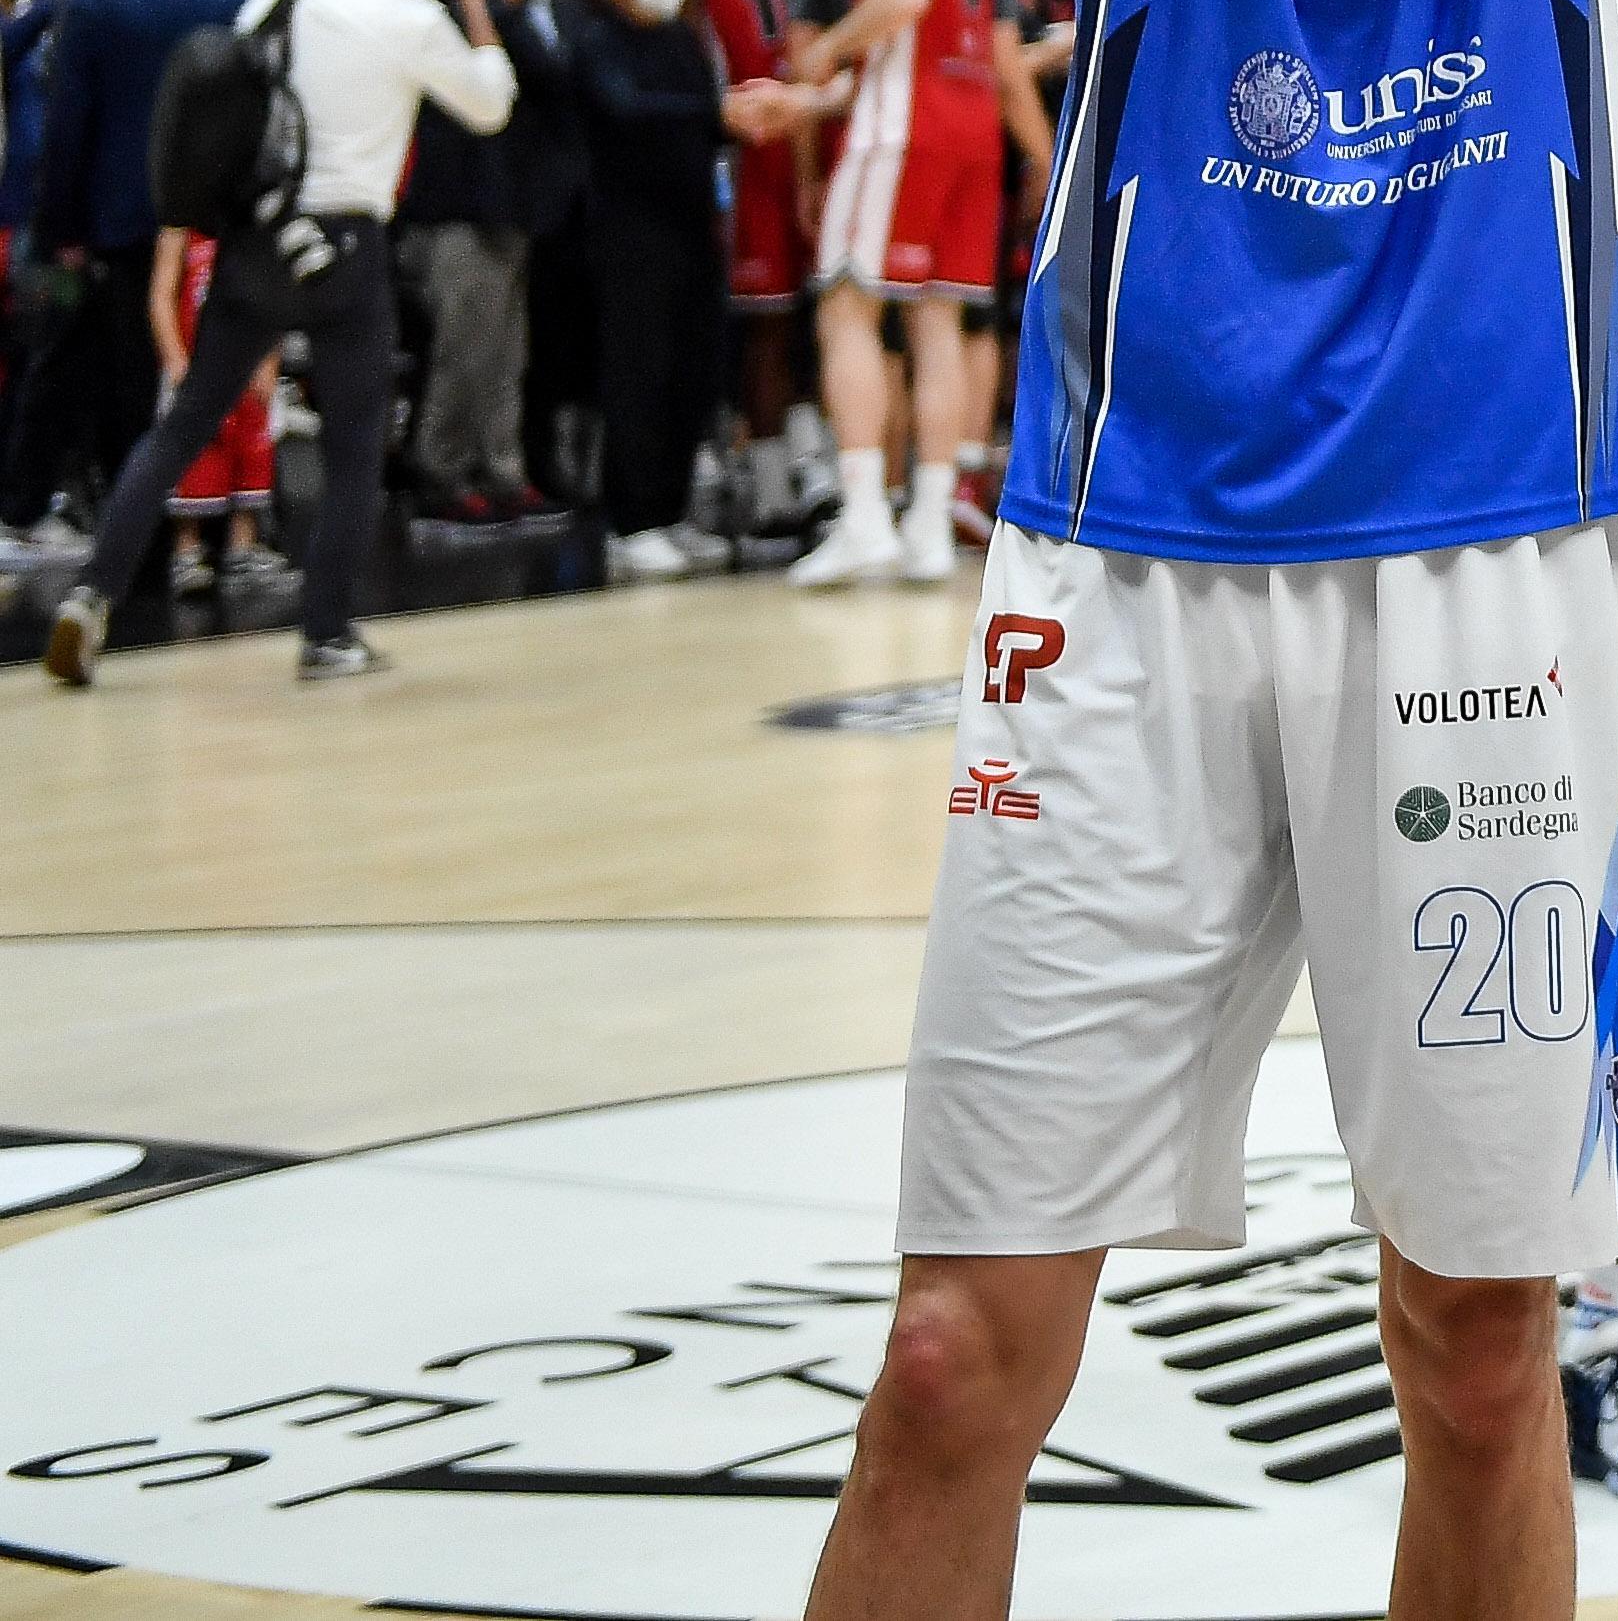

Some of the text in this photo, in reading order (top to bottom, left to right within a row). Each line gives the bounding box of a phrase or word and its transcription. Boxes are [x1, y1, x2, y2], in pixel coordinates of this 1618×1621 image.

[1326, 131, 1395, 160] UNIVERSITÀ
[1200, 156, 1253, 191] UN
[1252, 167, 1376, 207] FUTURO
[1394, 684, 1548, 725] VOLOTEA
[1457, 774, 1573, 808] Banco di
[1457, 809, 1579, 842] Sardegna
[1413, 880, 1589, 1048] 20
